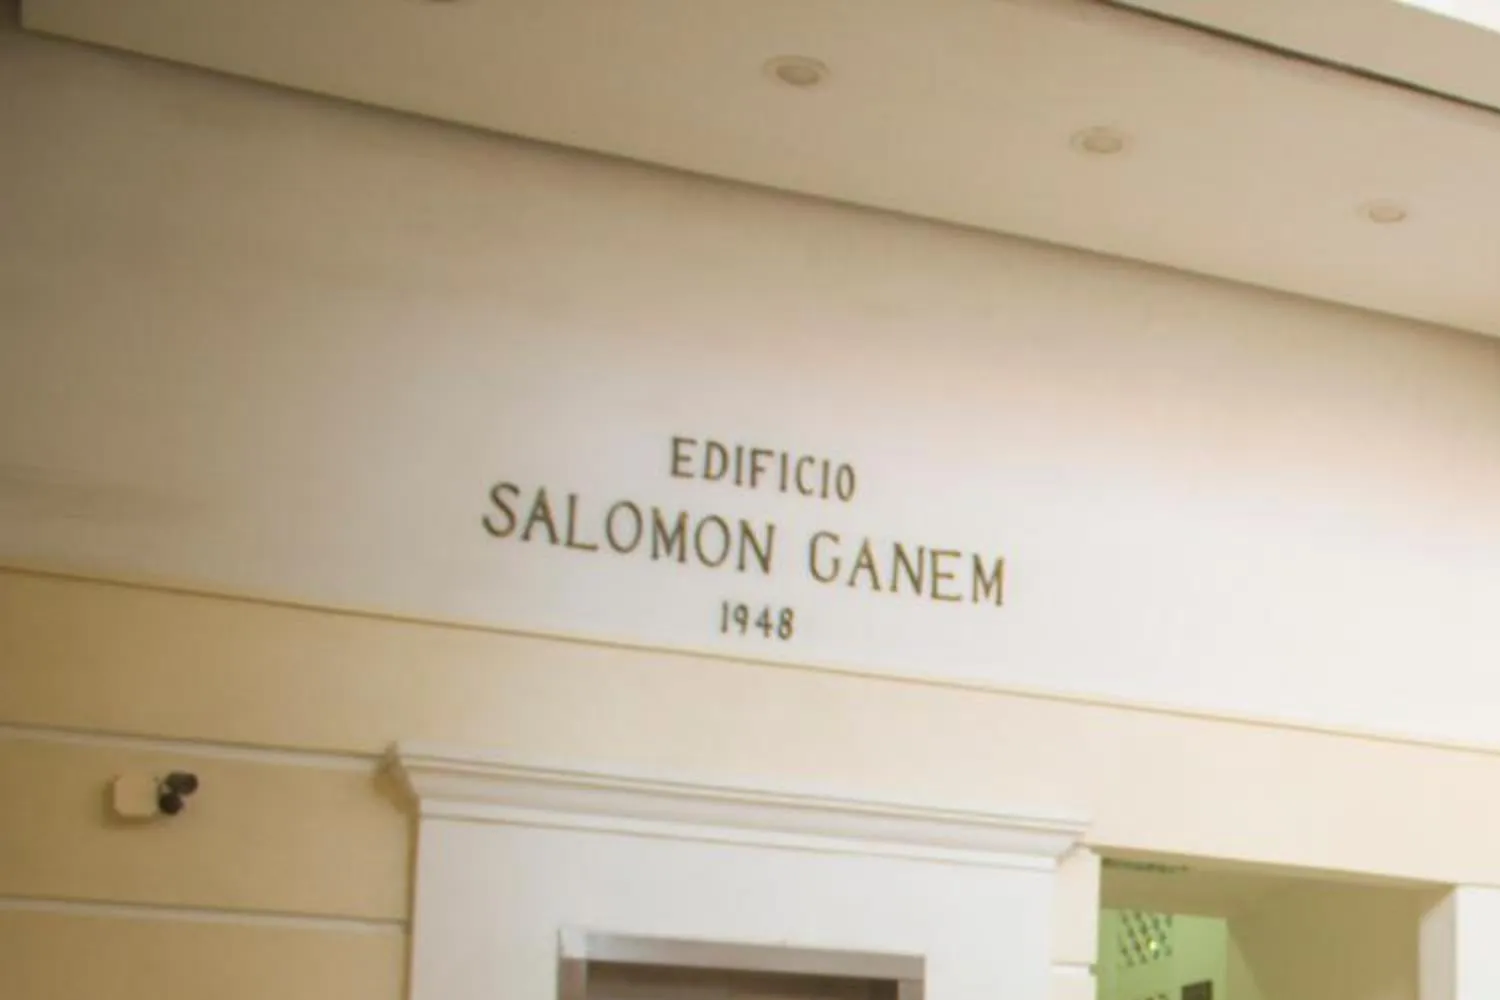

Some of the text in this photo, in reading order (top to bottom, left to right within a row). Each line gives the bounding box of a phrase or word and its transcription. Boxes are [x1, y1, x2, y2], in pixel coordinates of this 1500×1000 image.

[669, 436, 856, 502] EDIFICIO
[481, 481, 1006, 608] SALOMON GANEM
[719, 600, 795, 640] 1948
